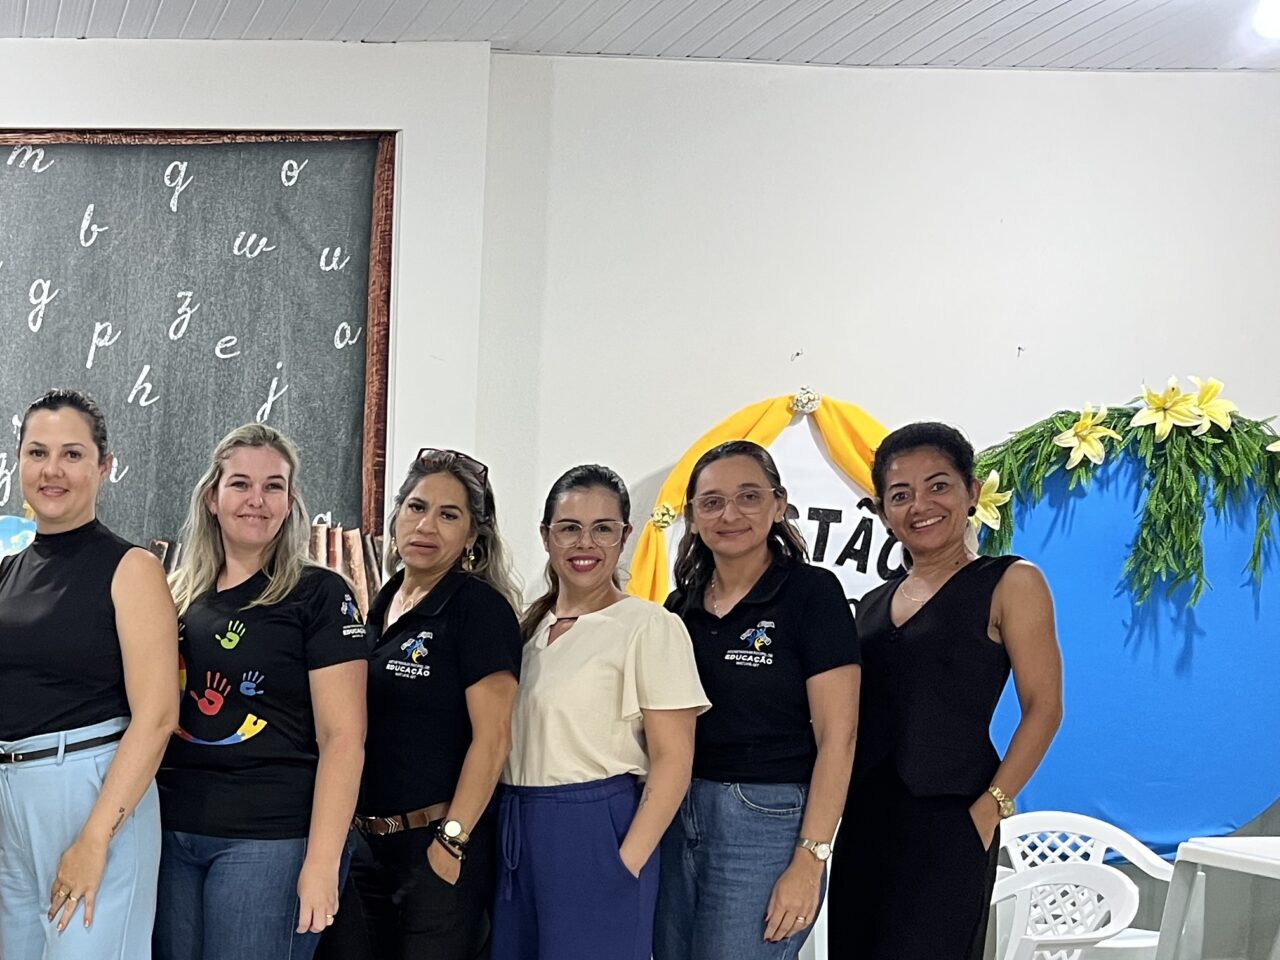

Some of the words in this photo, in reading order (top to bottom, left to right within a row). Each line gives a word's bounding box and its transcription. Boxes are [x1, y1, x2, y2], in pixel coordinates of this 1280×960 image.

[6, 143, 55, 173] m
[319, 246, 350, 272] u
[27, 277, 59, 333] g
[85, 321, 122, 369] p
[213, 334, 242, 359] e
[385, 663, 430, 677] EDUCAÇÃO
[724, 653, 774, 665] EDUCAÇÃO
